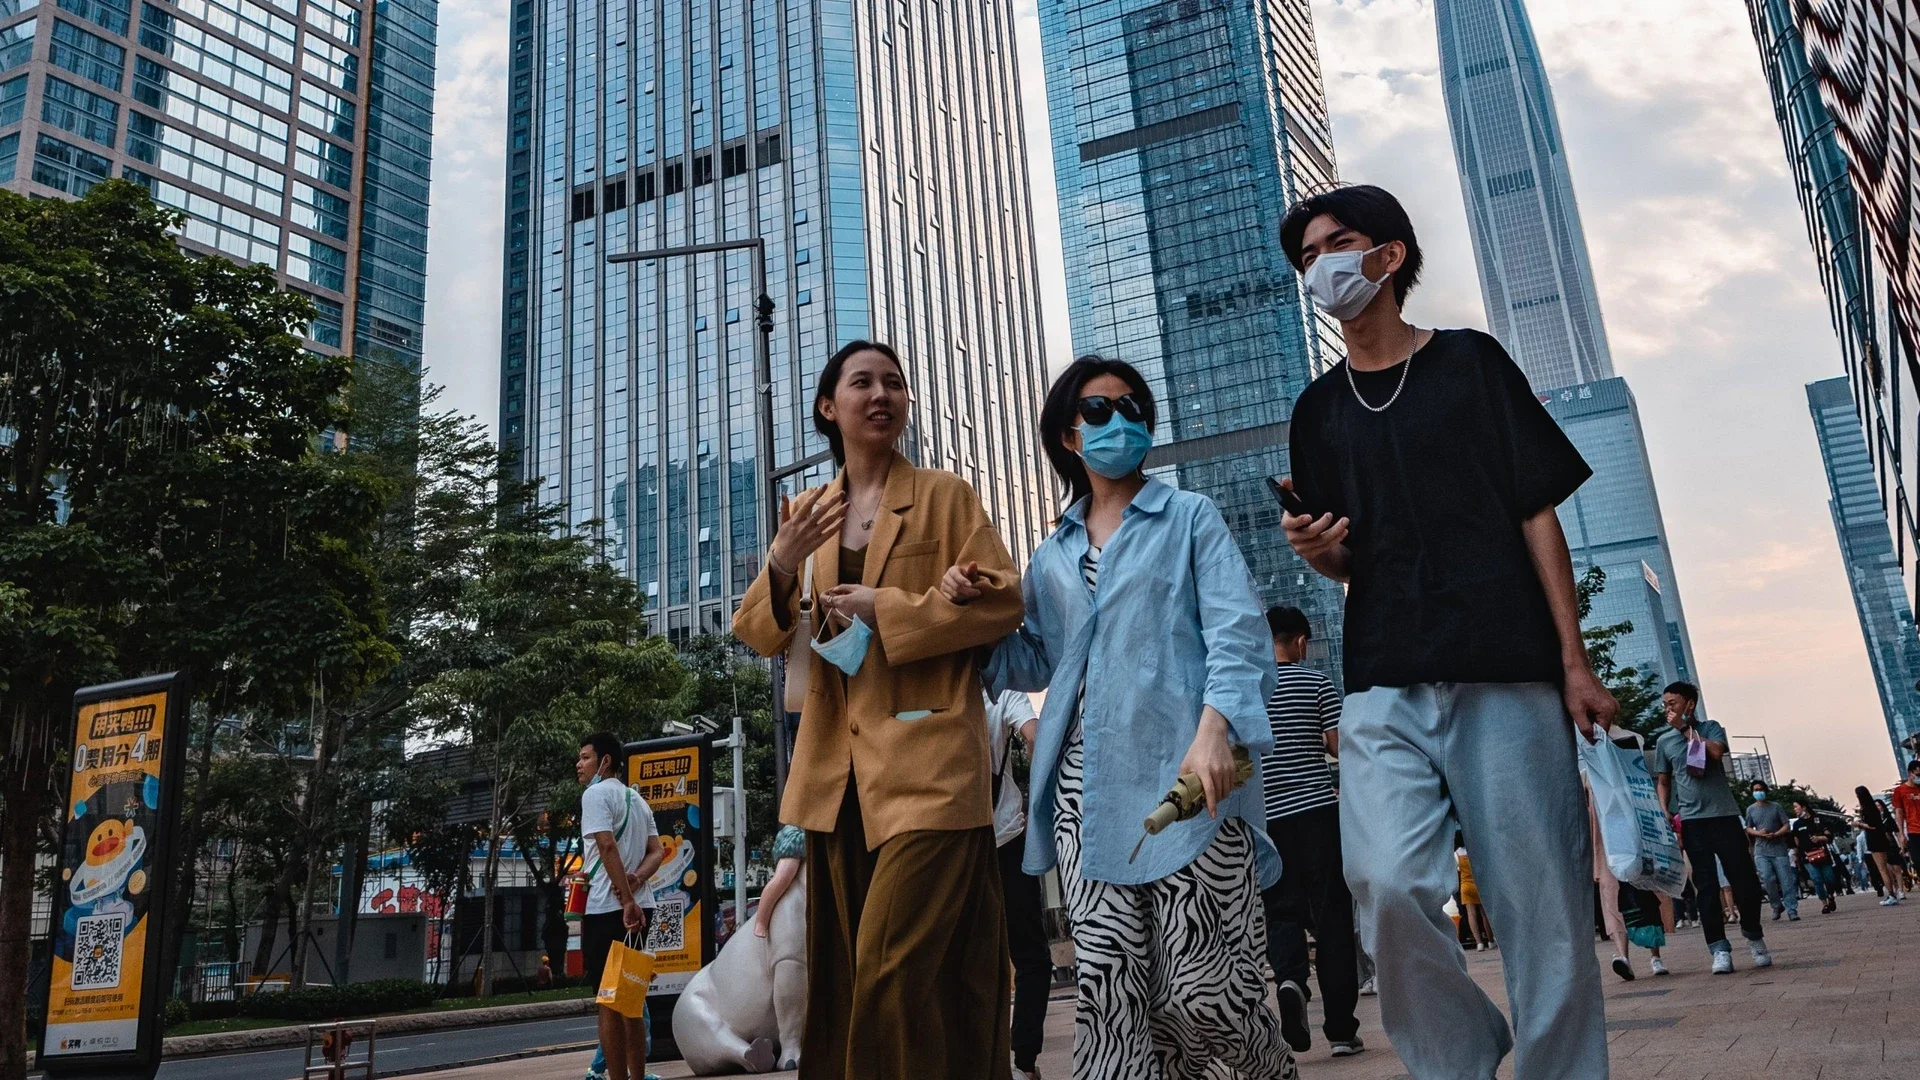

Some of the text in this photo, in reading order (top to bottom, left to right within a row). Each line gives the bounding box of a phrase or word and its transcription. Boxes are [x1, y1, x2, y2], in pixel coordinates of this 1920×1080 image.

[1560, 386, 1593, 403] 卓越
[93, 708, 152, 736] 用买鸭!!!
[74, 733, 161, 773] 0费用分4期
[643, 758, 688, 777] 用买鸭!!!
